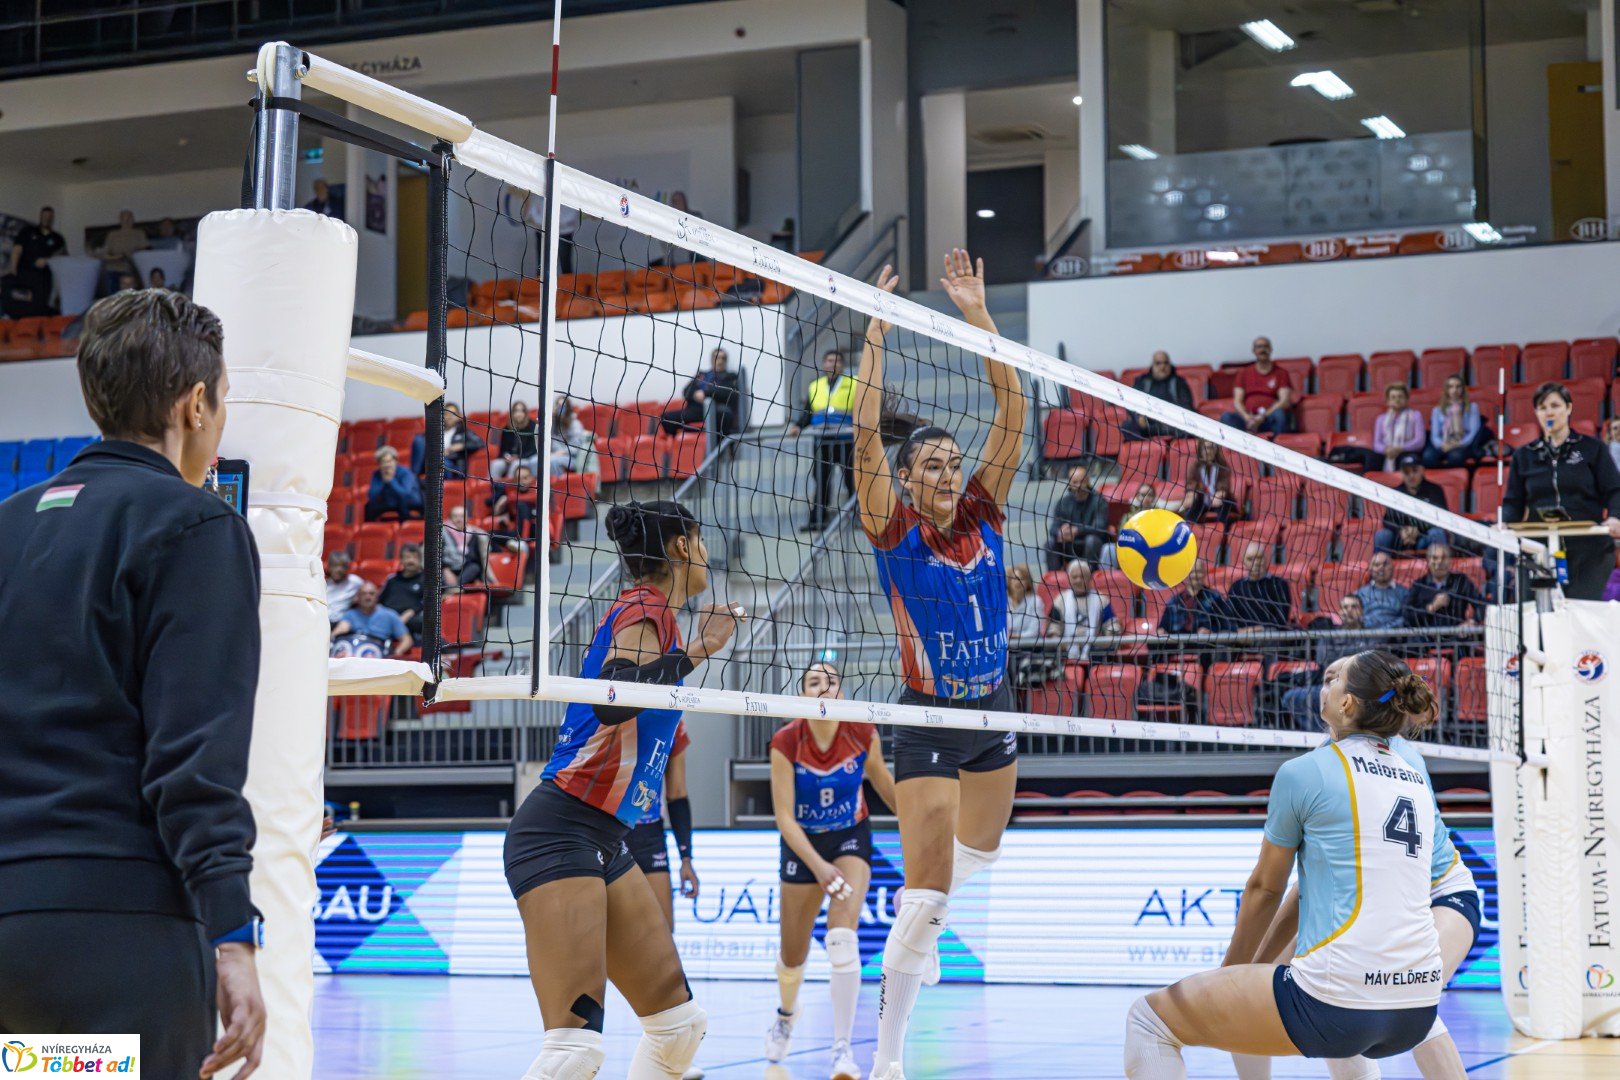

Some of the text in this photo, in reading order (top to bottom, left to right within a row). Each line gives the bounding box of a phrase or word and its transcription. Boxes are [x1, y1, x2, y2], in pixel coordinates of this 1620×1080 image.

[968, 594, 983, 632] 1
[1352, 756, 1424, 785] Maiorano
[819, 787, 835, 808] 8
[1382, 796, 1422, 858] 4
[1364, 969, 1391, 986] MÁV
